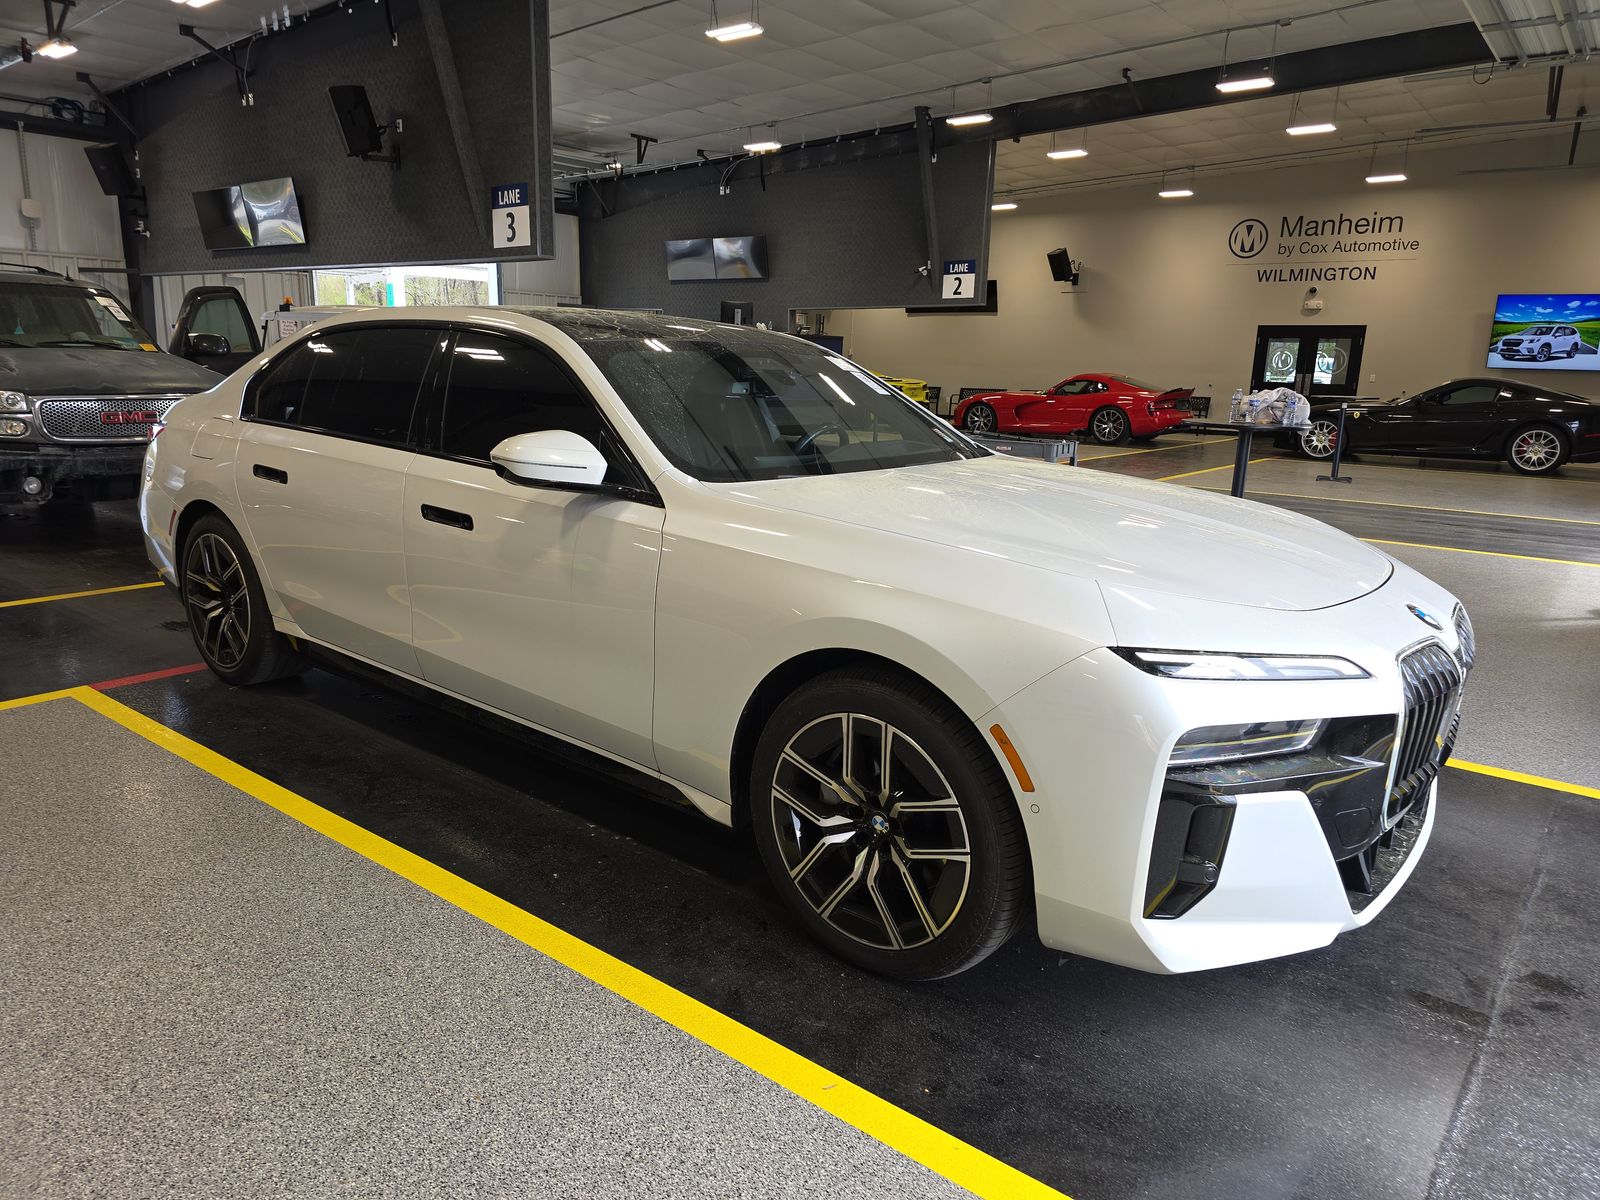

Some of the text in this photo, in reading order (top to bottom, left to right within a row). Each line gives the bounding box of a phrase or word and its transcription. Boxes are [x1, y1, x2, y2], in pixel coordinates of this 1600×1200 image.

[498, 188, 521, 205] LANE
[506, 212, 517, 243] 3
[1280, 211, 1404, 238] Manheim
[1278, 238, 1420, 258] by Cox Automotive
[949, 263, 969, 273] LANE
[1256, 266, 1377, 283] WILMINGTON
[952, 277, 962, 296] 2
[101, 411, 160, 424] GMC
